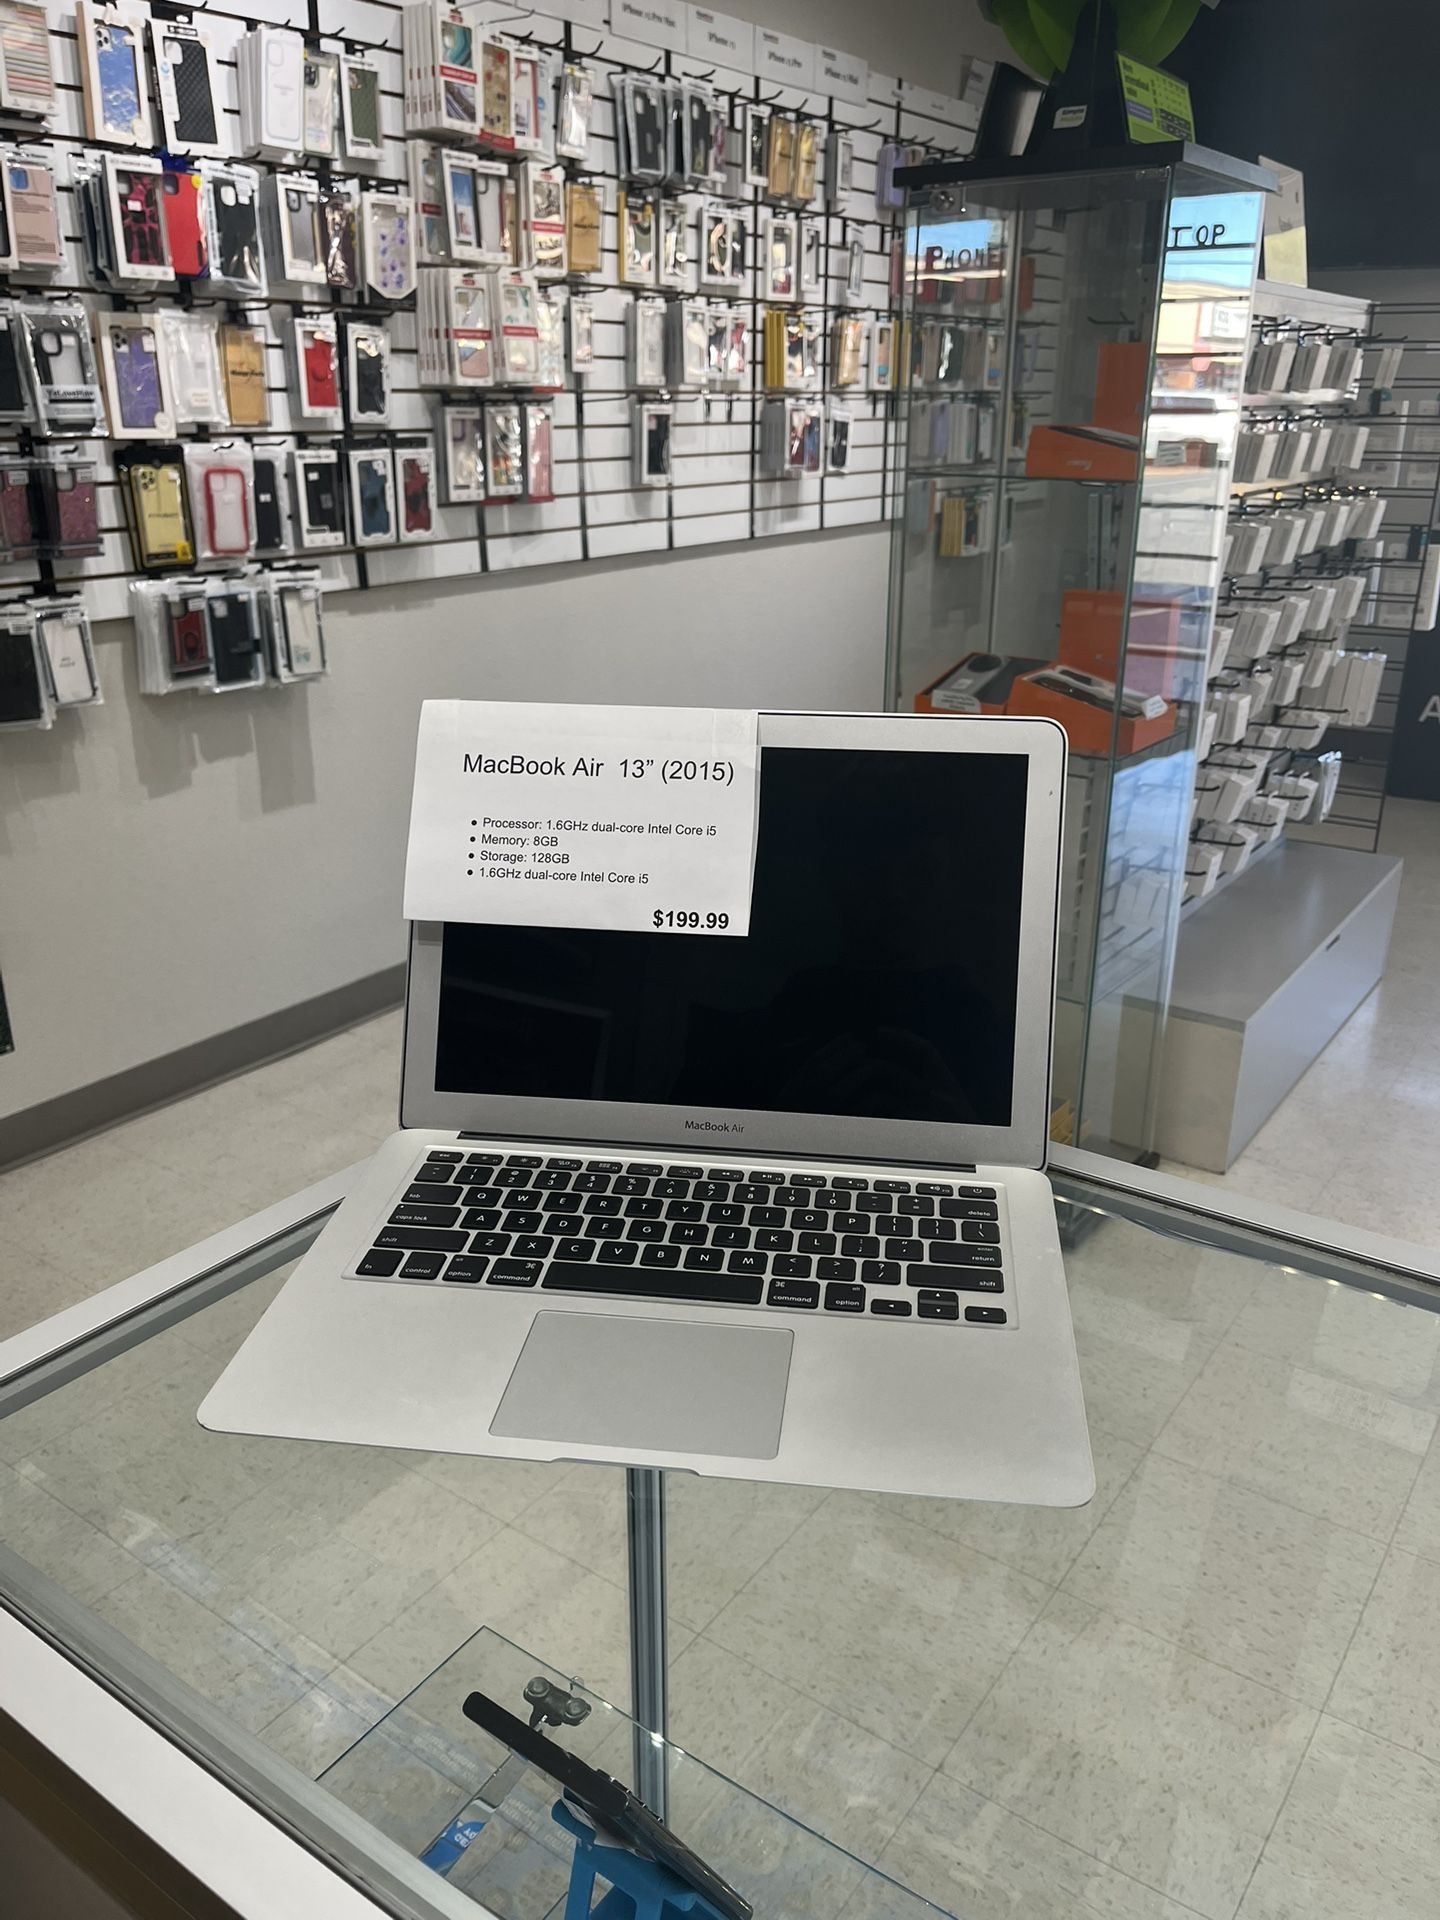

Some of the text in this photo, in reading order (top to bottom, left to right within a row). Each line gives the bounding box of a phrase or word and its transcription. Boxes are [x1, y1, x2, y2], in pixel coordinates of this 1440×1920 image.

[463, 753, 566, 777] MacBook
[572, 757, 604, 777] Air
[661, 759, 735, 786] (2015)
[482, 817, 717, 837] Processor: 1.6GHz dual-core Intel Core i5
[481, 833, 559, 848] Memory: 8GB
[480, 850, 570, 864] Storage: 128GB
[479, 867, 649, 884] 1.6GHz dual-core Intel Core i5
[652, 907, 730, 931] $199.99
[685, 1120, 745, 1133] MacBook Air
[559, 1197, 566, 1205] E
[599, 1200, 608, 1208] R
[485, 1238, 495, 1246] Z
[814, 1238, 820, 1246] L
[614, 1247, 623, 1255] V
[657, 1250, 665, 1258] B
[742, 1257, 754, 1265] M
[447, 1270, 472, 1278] option
[492, 1274, 531, 1282] command
[773, 1295, 812, 1303] command
